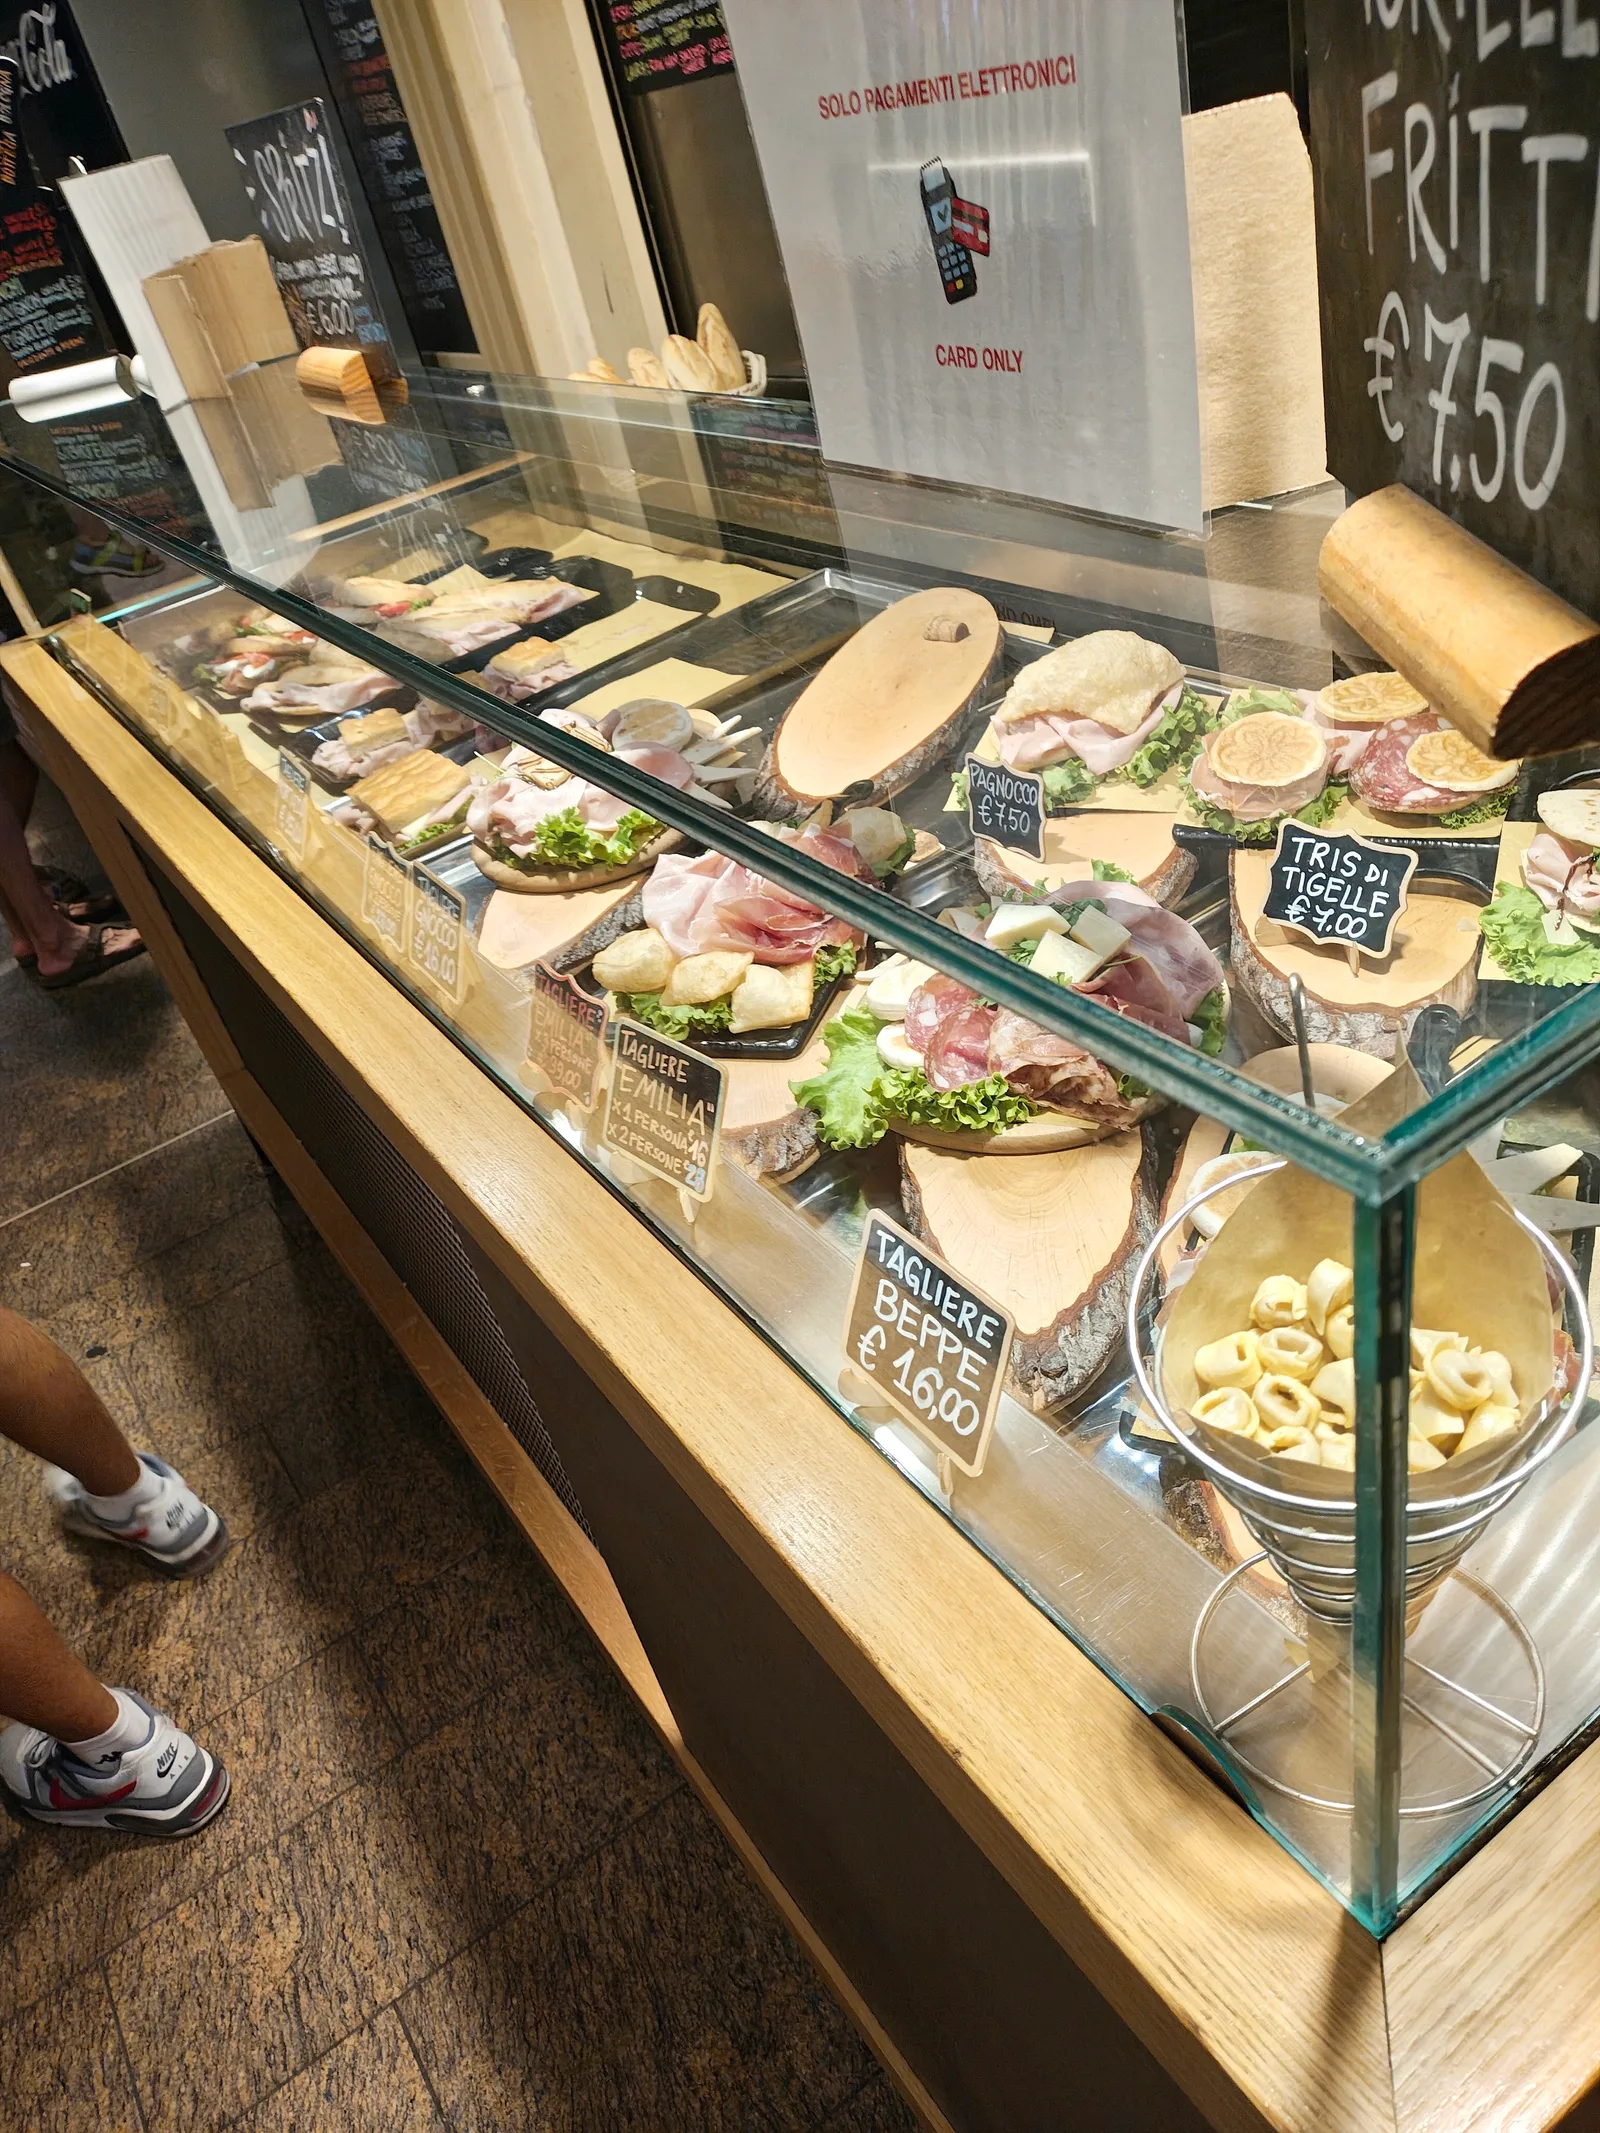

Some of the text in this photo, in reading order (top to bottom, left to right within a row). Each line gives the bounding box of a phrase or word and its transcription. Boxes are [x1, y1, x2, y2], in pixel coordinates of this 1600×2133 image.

[818, 54, 1077, 120] SOLO PAGAMENTI ELETTRONICI
[936, 344, 1023, 373] CARD ONLY
[969, 763, 1038, 807] PAGNOCCO
[1291, 837, 1389, 887] TRIS DI
[1282, 866, 1390, 918] TIGELLE
[537, 974, 597, 1031] TAGLIERE
[621, 1030, 690, 1083] TAGLIERE
[629, 1132, 682, 1175] PERSONE
[634, 1109, 689, 1155] PERSONA
[876, 1229, 999, 1349] TAGLIERE
[874, 1279, 988, 1391] BEPPE
[157, 1742, 175, 1770] NIKE
